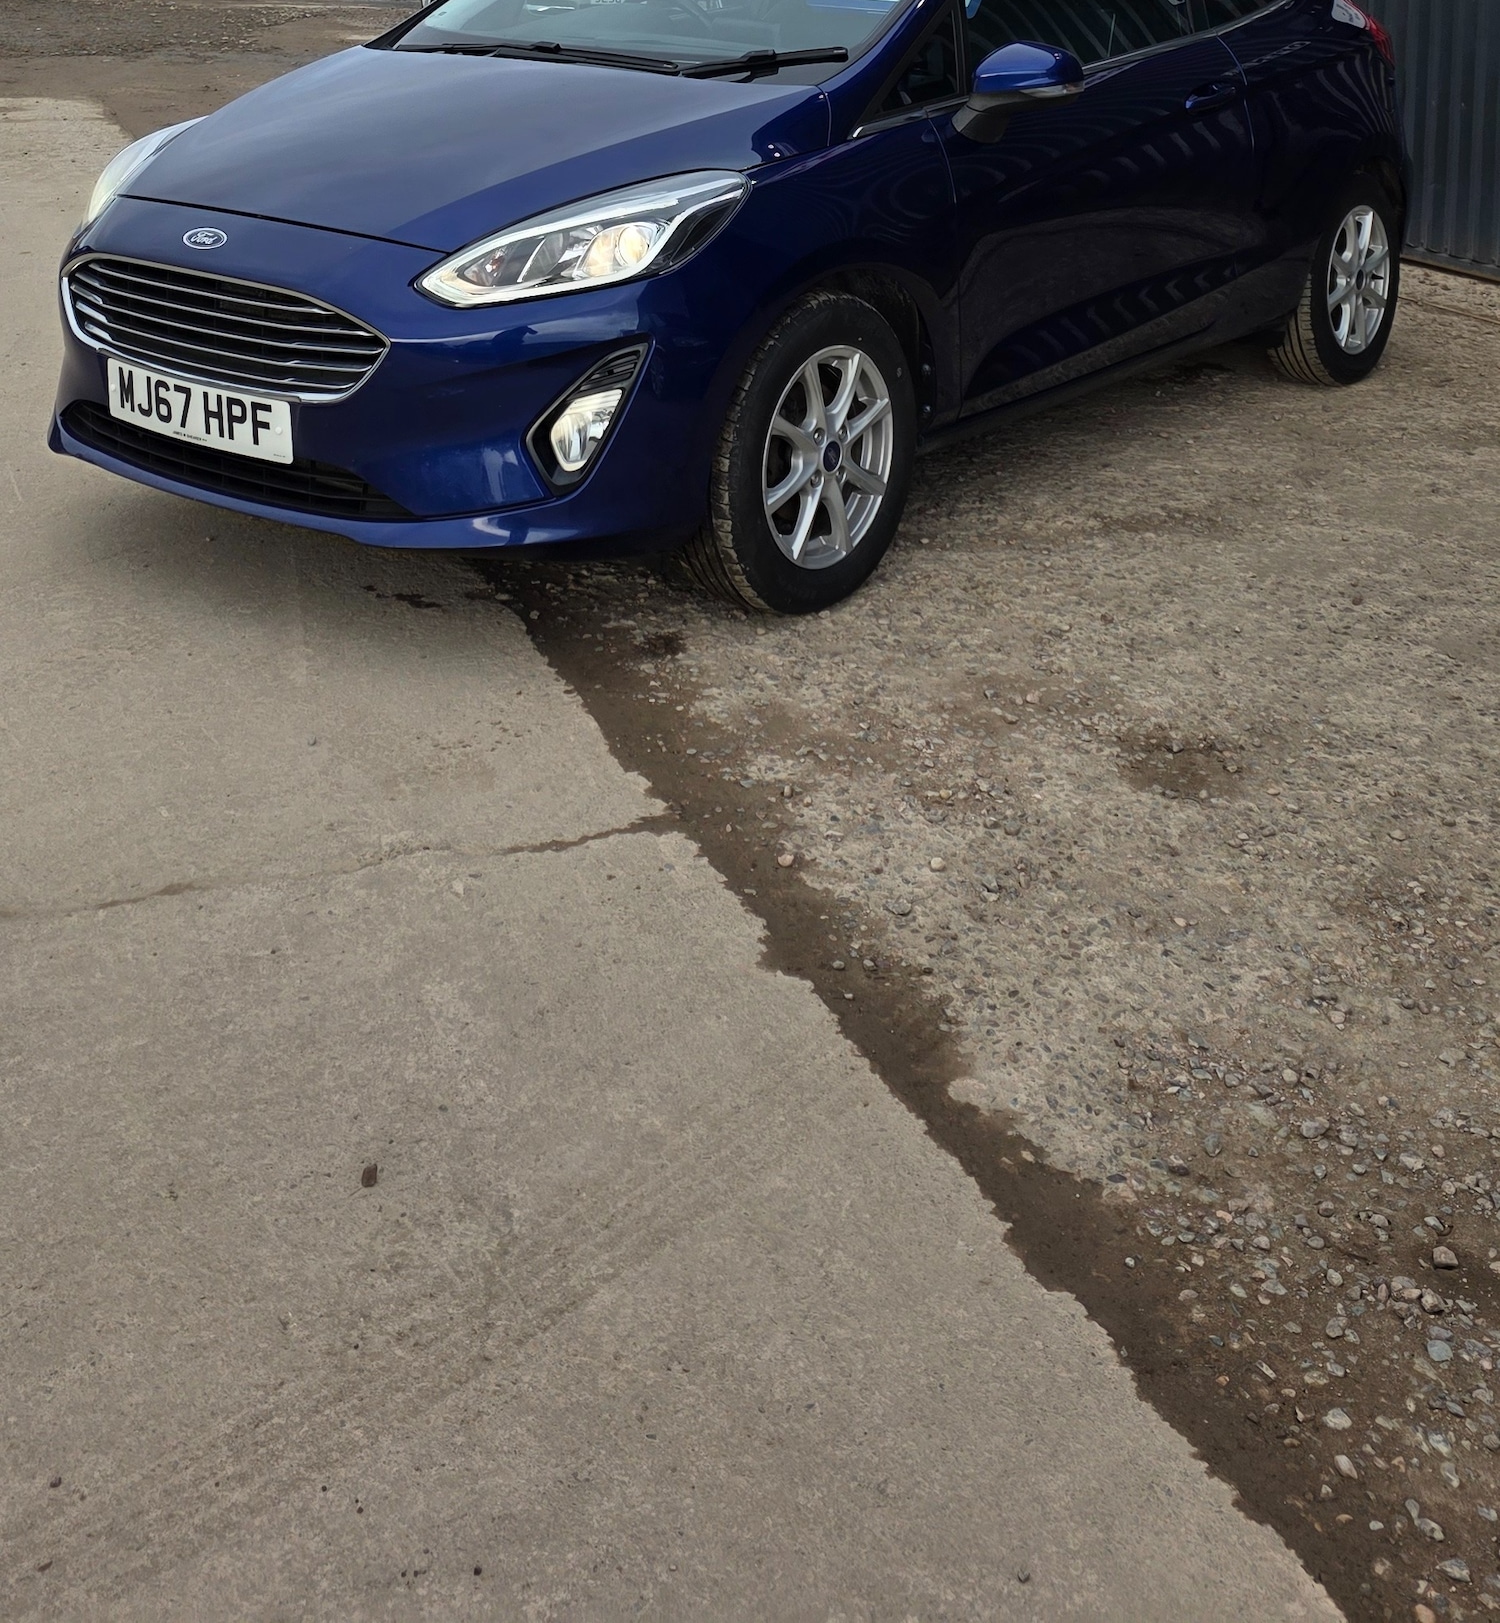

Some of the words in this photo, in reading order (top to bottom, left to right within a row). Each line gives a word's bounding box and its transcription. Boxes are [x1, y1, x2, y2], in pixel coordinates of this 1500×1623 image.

[190, 231, 218, 245] Ford
[118, 366, 191, 429] MJ67
[203, 391, 273, 446] HPF
